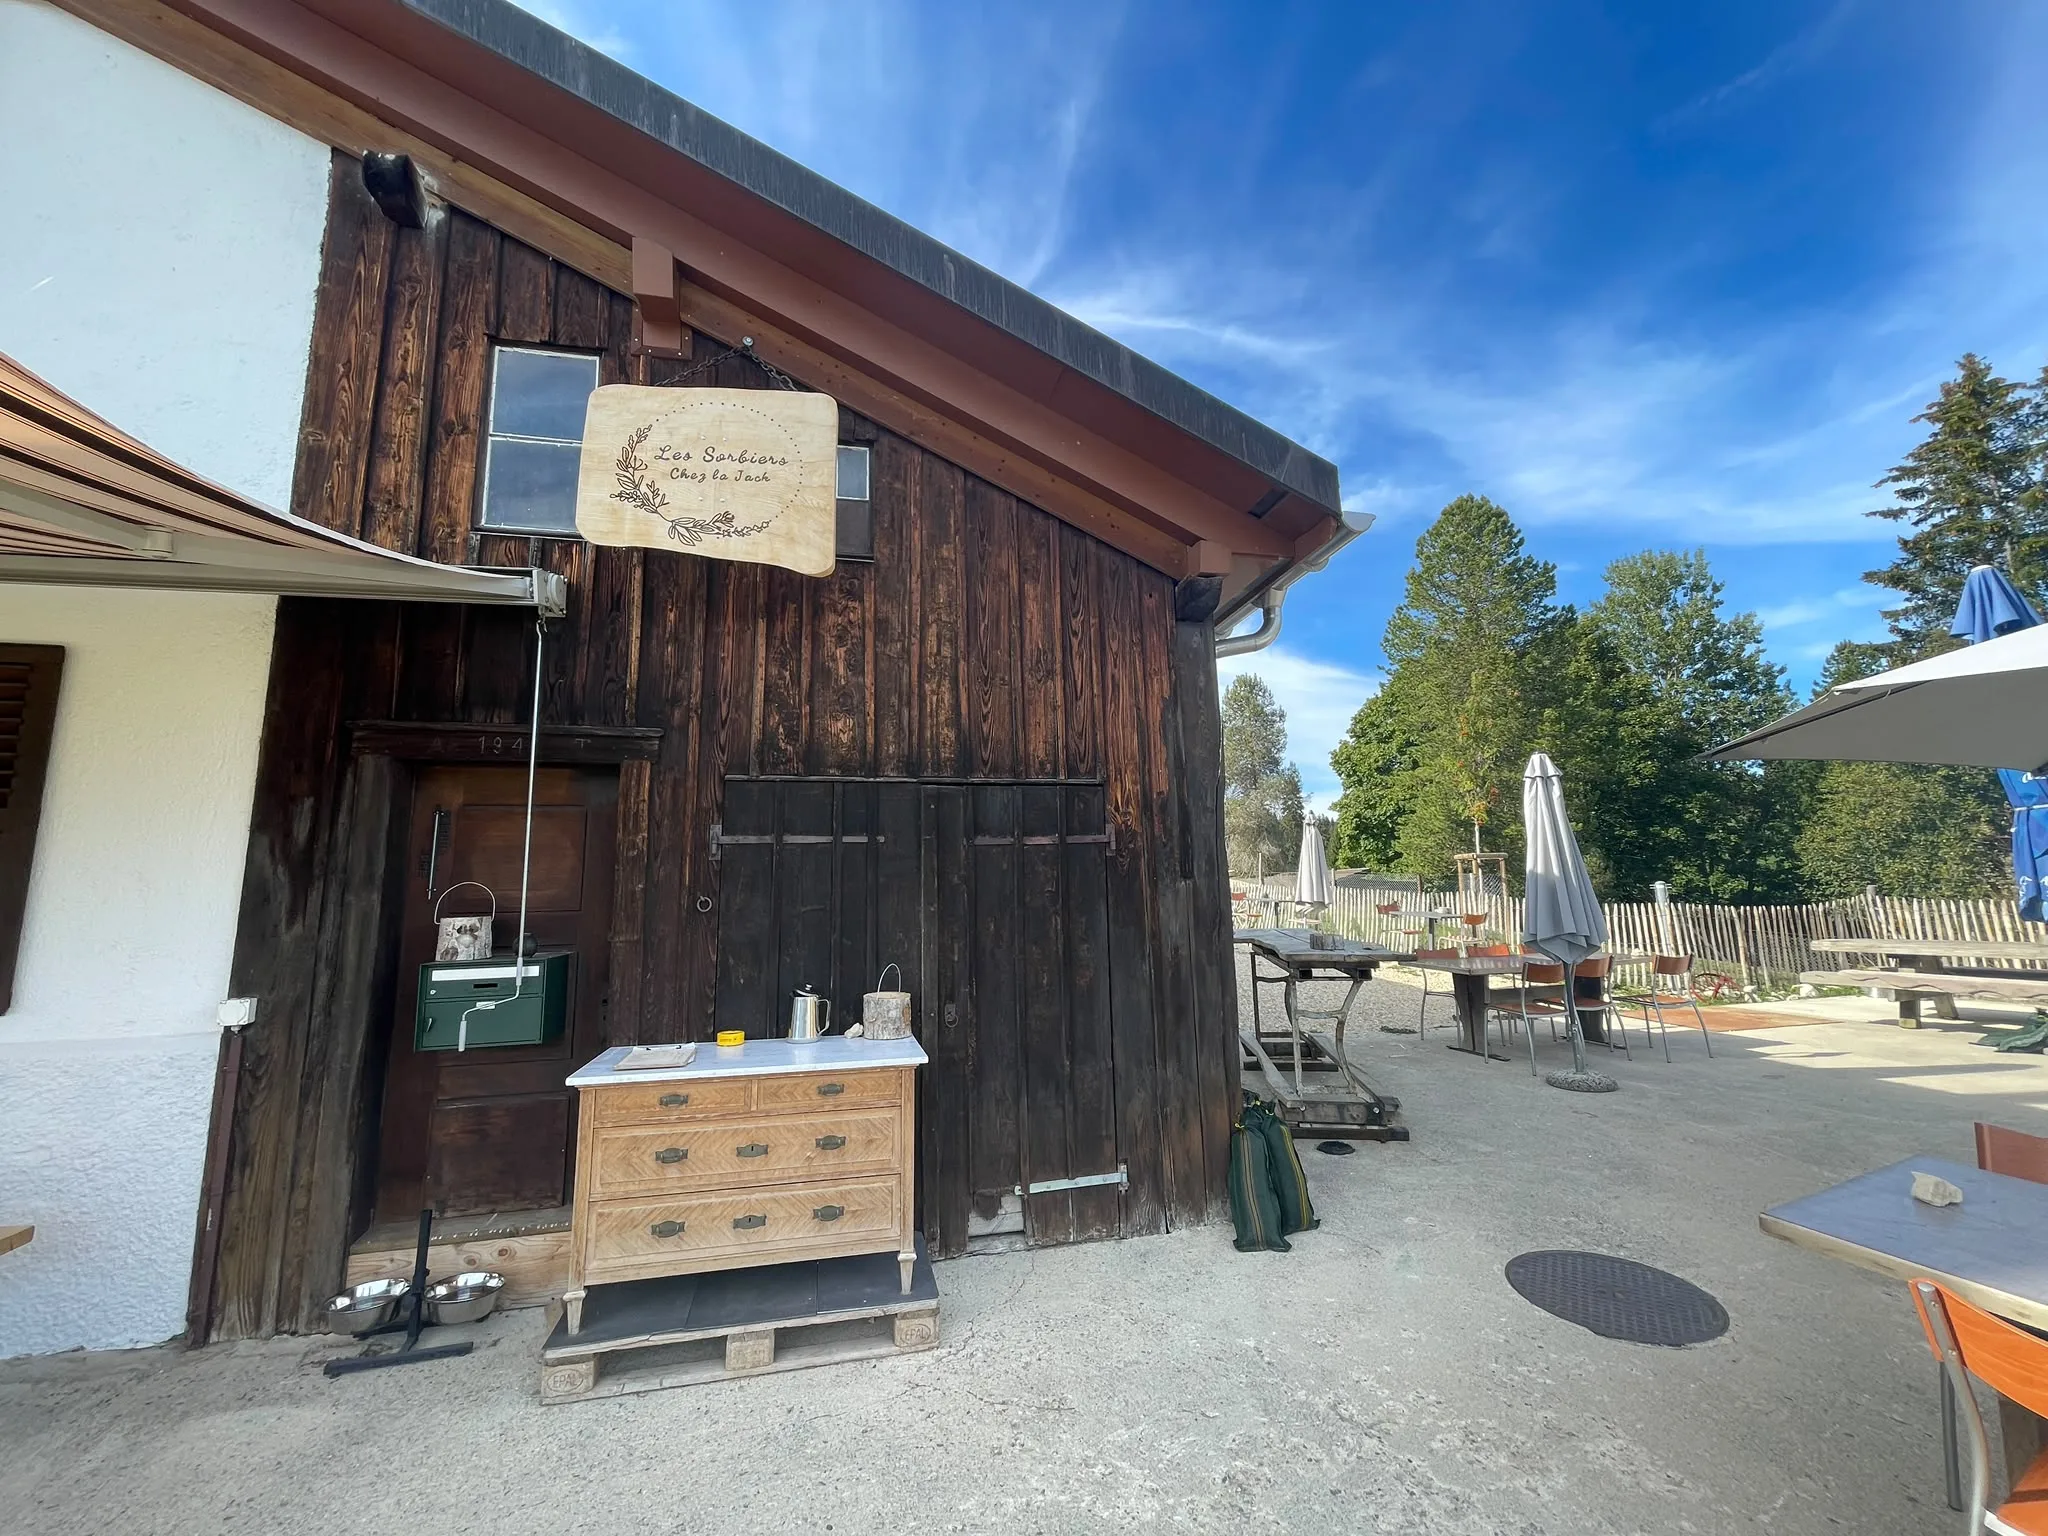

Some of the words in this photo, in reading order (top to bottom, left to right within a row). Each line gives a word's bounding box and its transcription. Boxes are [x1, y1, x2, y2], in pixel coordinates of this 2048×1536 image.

[654, 444, 693, 462] Les
[702, 446, 789, 466] Sorbiers
[669, 467, 707, 484] Chez
[712, 468, 729, 481] la
[734, 469, 771, 483] Jack
[478, 735, 535, 754] 194
[552, 1371, 578, 1389] EPAL
